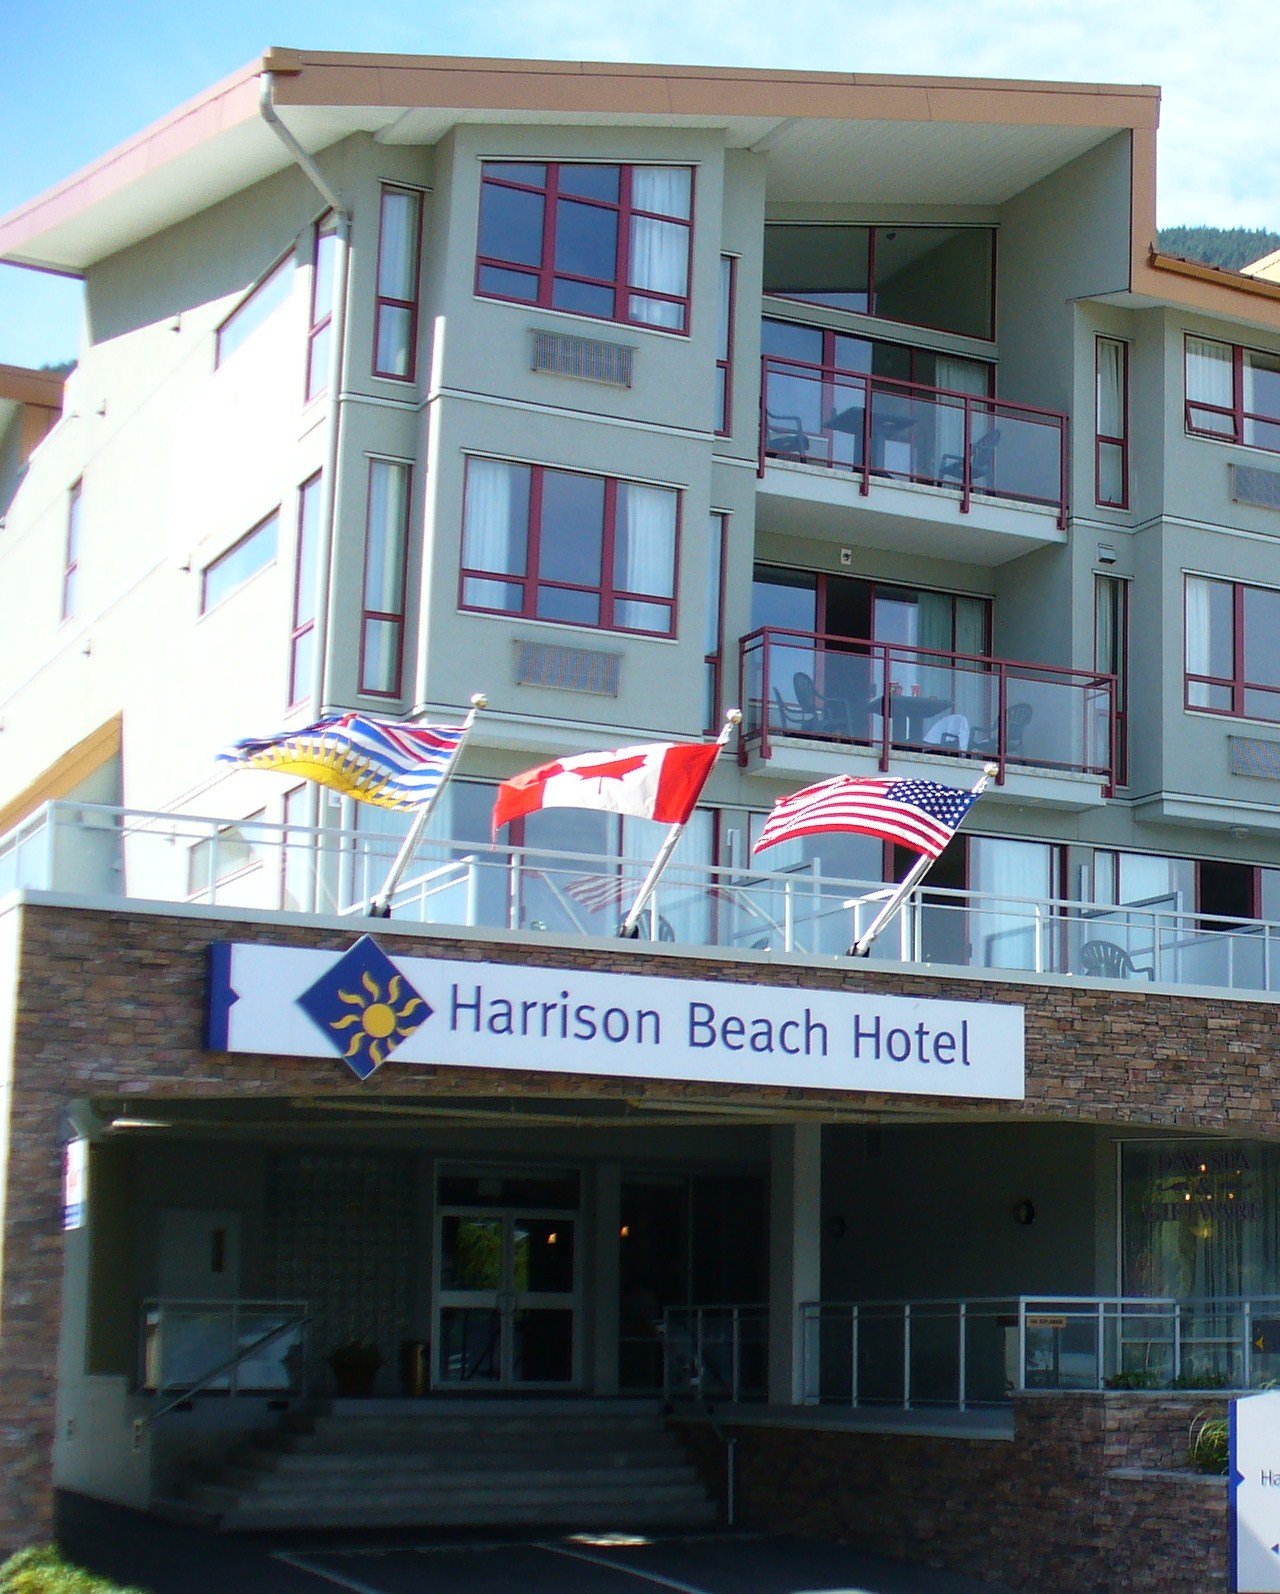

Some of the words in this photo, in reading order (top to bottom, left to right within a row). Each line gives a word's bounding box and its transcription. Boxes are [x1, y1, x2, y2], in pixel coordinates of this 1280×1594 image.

[450, 983, 662, 1046] Harrison
[687, 1001, 830, 1056] Beach
[853, 1015, 972, 1067] Hotel
[1211, 1152, 1250, 1169] SPA
